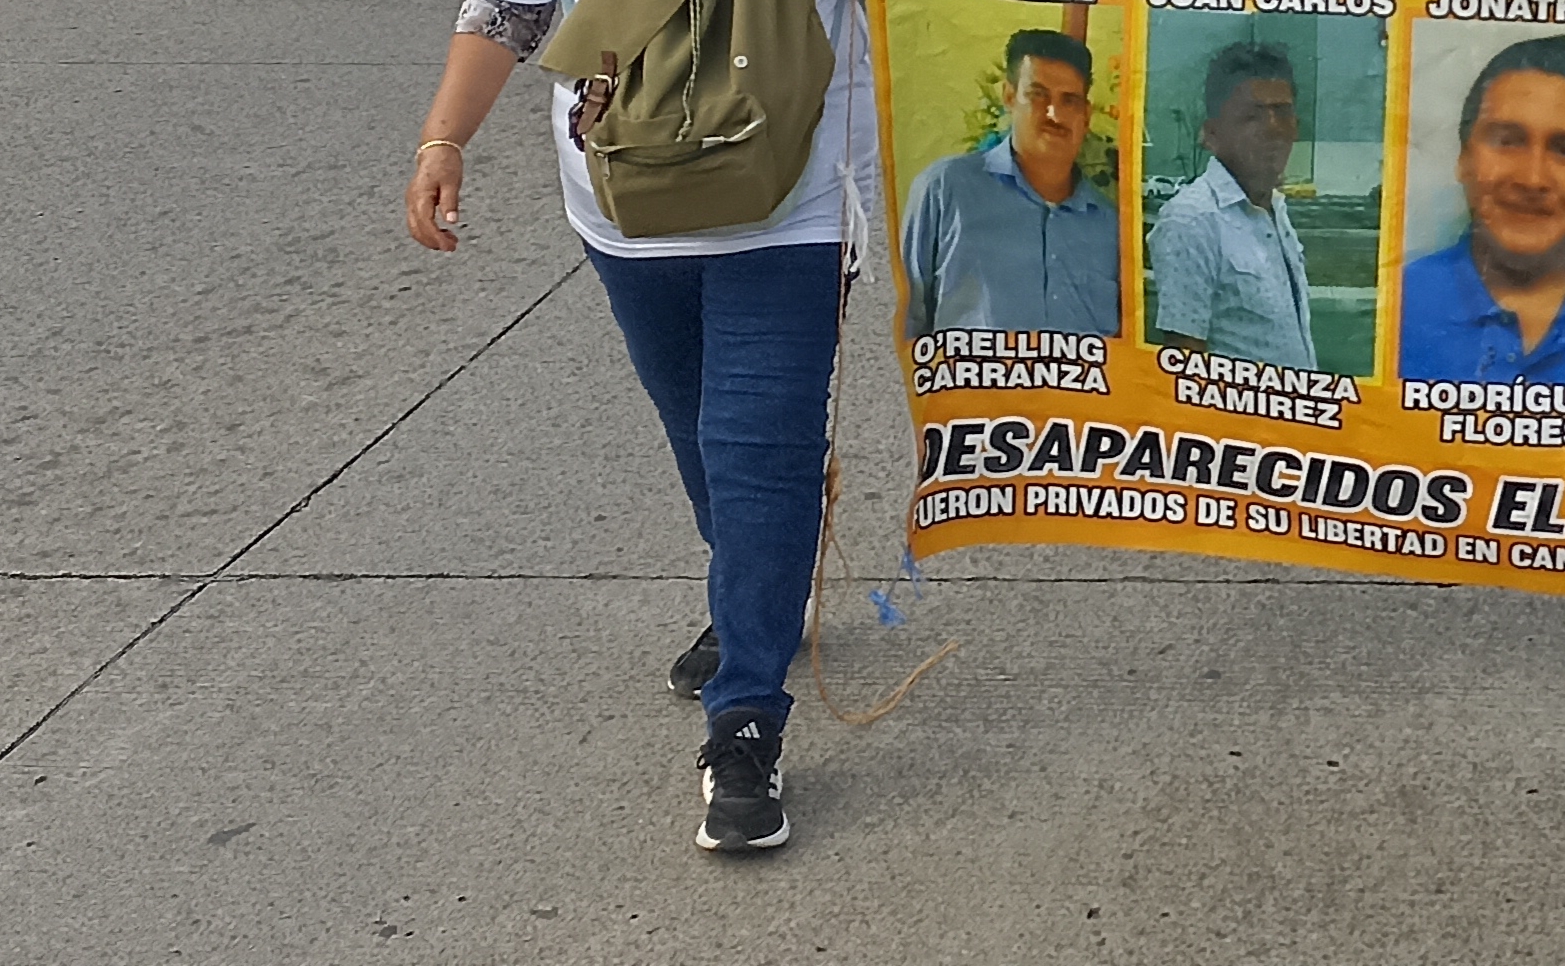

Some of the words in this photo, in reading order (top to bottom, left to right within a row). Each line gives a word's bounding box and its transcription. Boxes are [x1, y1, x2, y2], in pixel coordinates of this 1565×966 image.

[912, 360, 1108, 397] CARRANZA
[1158, 346, 1360, 404] CARRANZA
[1177, 377, 1344, 430] RAMÍREZ
[920, 416, 1473, 525] DESAPARECIDOS
[1026, 484, 1186, 524] PRIVADOS
[1198, 496, 1235, 527] DE
[1248, 504, 1290, 535] SU
[1299, 511, 1445, 560] LIBERTAD
[1457, 534, 1499, 564] EN
